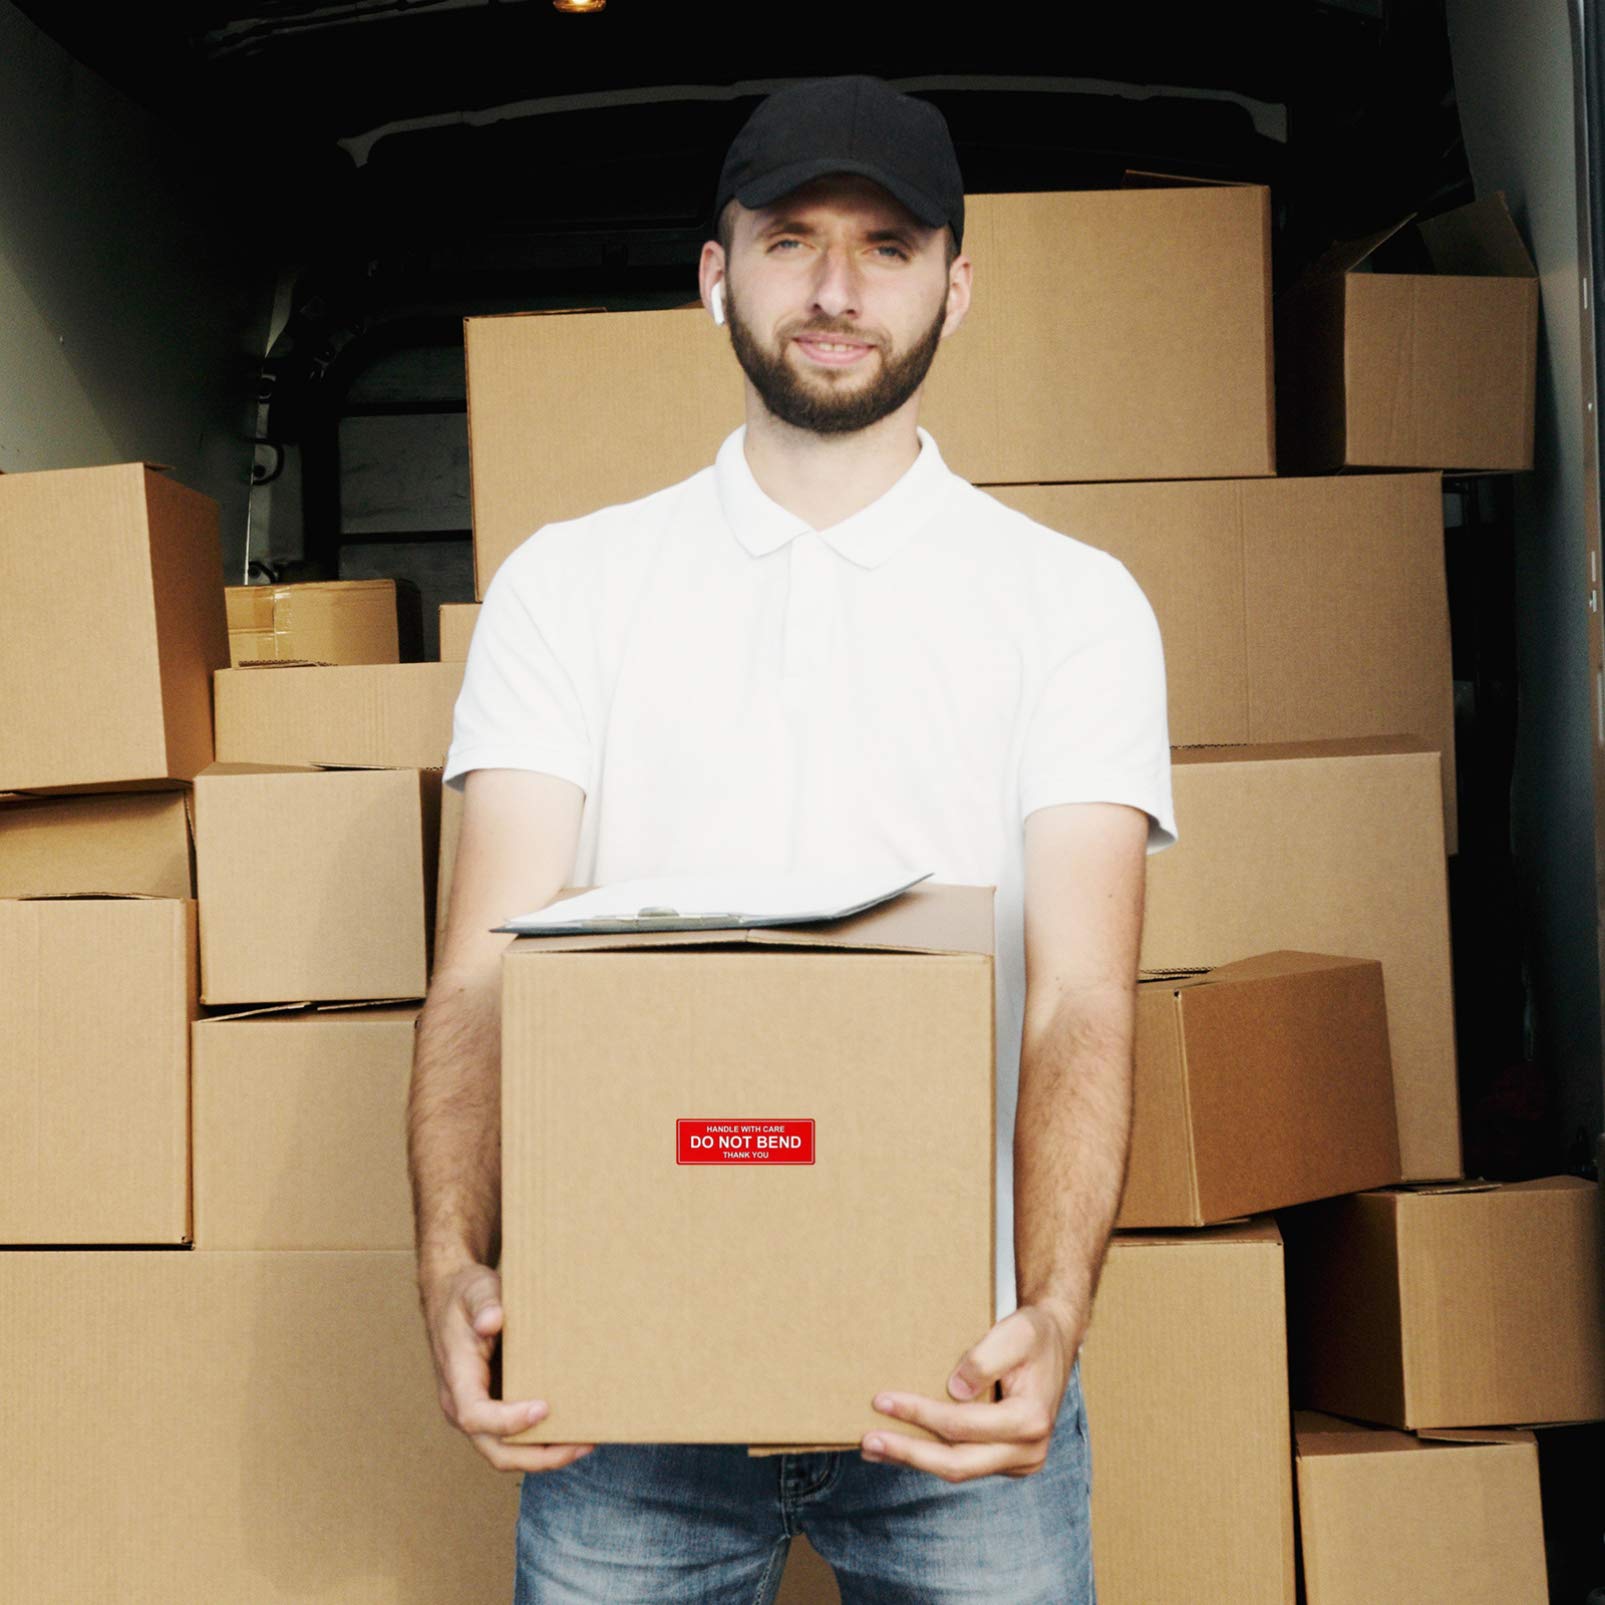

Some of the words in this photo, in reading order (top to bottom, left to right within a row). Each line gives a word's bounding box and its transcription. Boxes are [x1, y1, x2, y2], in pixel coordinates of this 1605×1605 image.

[706, 1125, 739, 1133] HANDLE
[741, 1125, 761, 1133] WITH
[763, 1125, 785, 1133] CARE
[690, 1135, 714, 1149] DO
[718, 1135, 752, 1149] NOT
[757, 1135, 802, 1149] BEND
[723, 1151, 750, 1159] THANK
[752, 1151, 769, 1159] YOU
